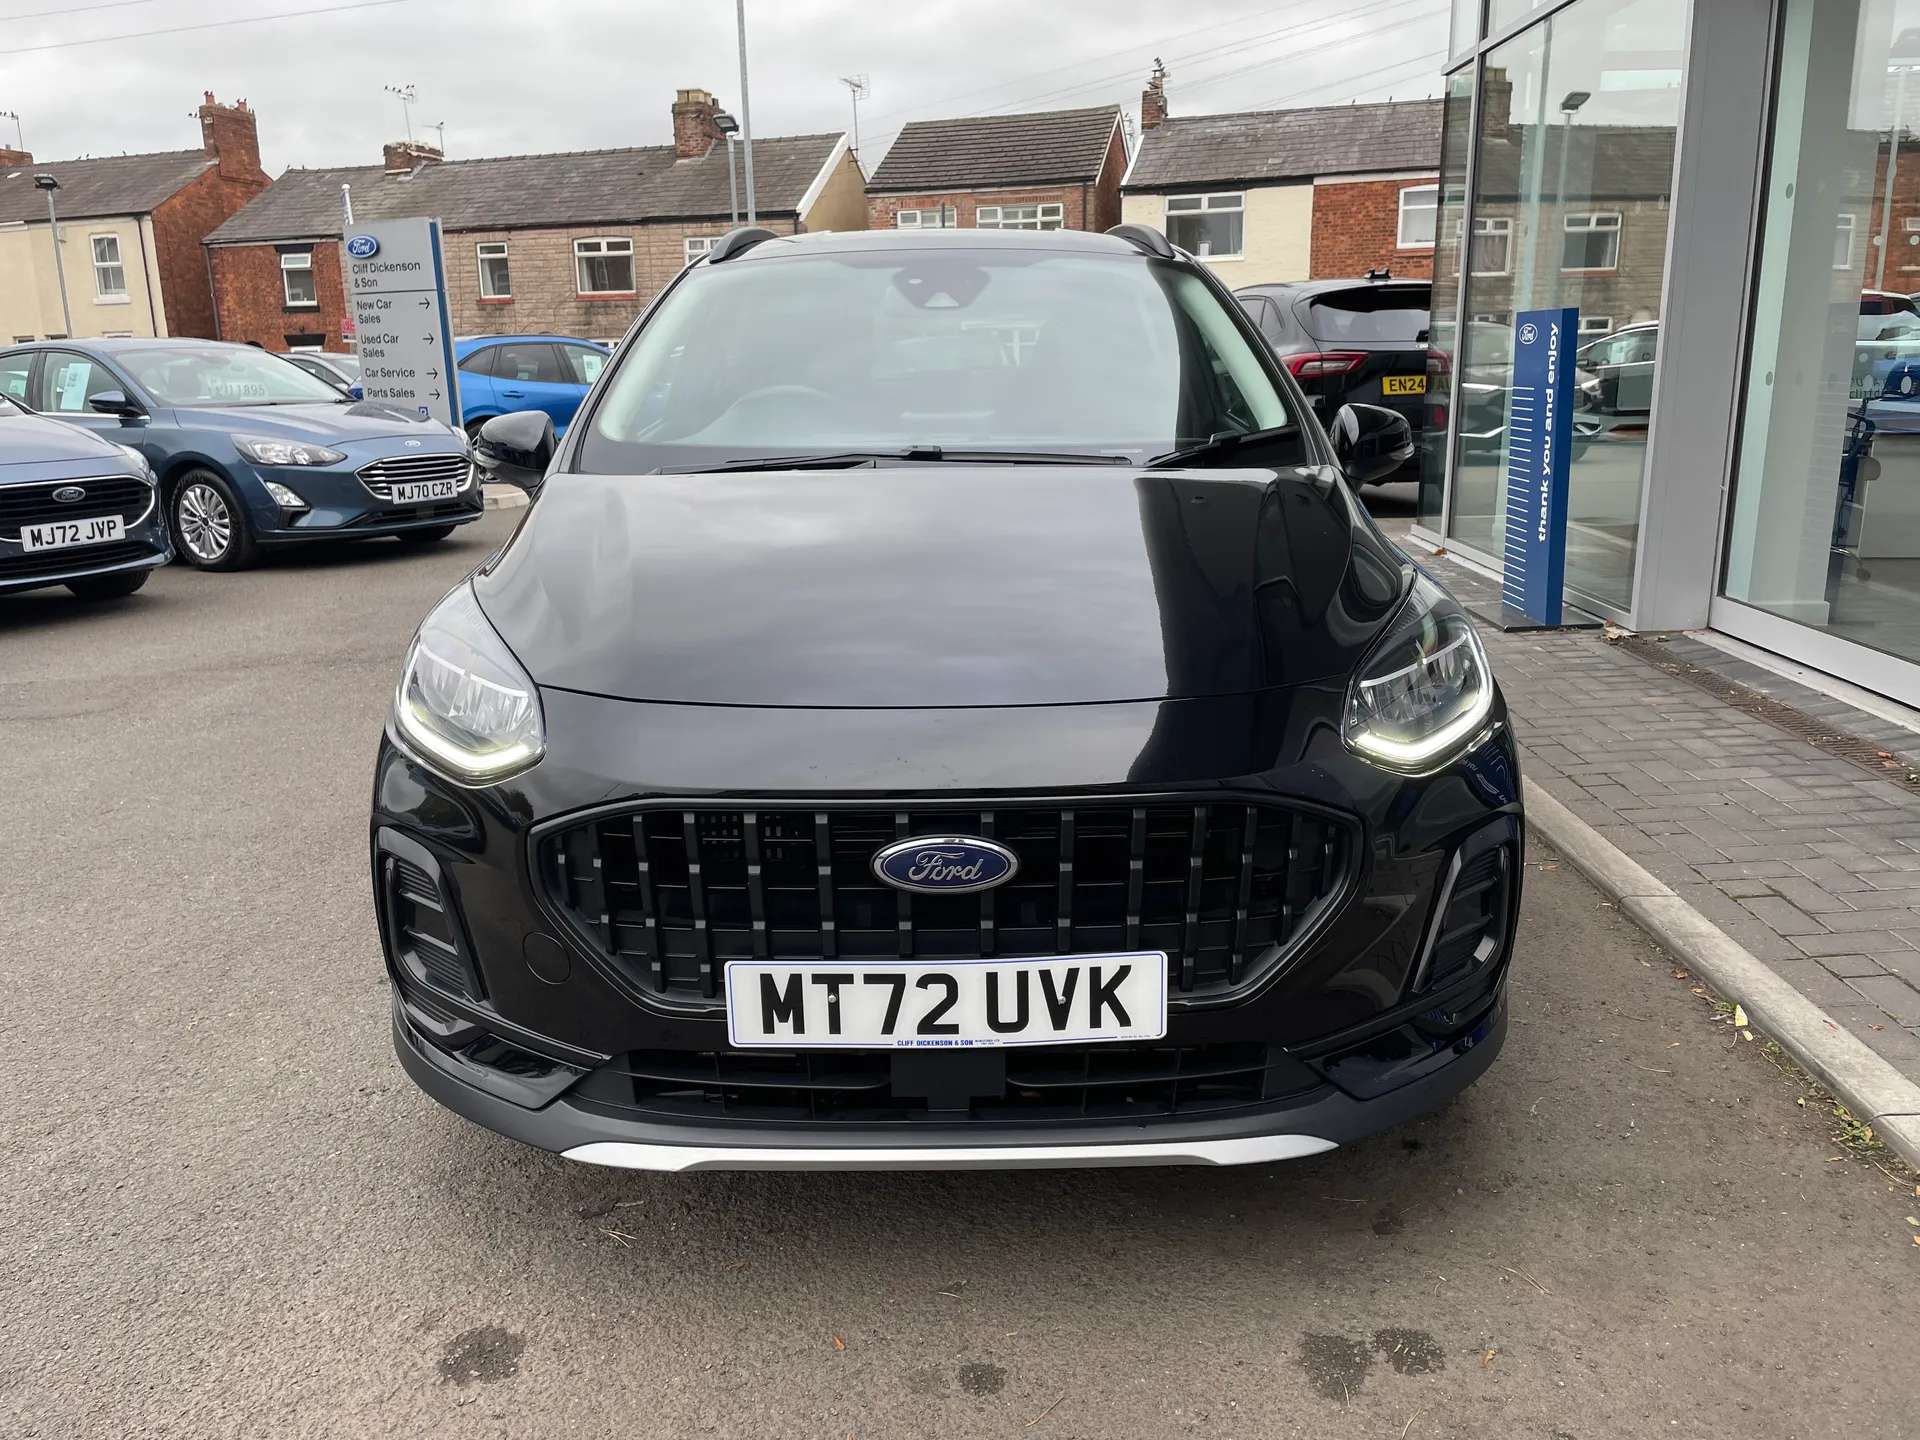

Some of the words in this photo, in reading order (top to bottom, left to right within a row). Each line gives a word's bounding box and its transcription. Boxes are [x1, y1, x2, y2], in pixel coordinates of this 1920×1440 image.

[352, 262, 368, 274] Cliff
[369, 261, 421, 273] Dickenson
[354, 278, 360, 288] &
[361, 277, 378, 288] Son
[356, 300, 374, 310] New
[376, 299, 392, 310] Car
[358, 314, 381, 324] Sales
[361, 334, 381, 345] Used
[383, 333, 399, 344] Car
[362, 347, 385, 358] Sales
[1547, 322, 1559, 384] enjoy
[365, 368, 379, 378] Car
[380, 367, 416, 378] Service
[1389, 378, 1425, 392] EN24
[367, 387, 388, 398] Parts
[389, 387, 416, 398] Sales
[1545, 388, 1554, 432] and
[1542, 435, 1551, 475] you
[397, 484, 429, 500] MJ70
[432, 481, 453, 497] CZR
[1538, 480, 1548, 543] thank
[30, 525, 81, 547] MJ72
[86, 520, 117, 540] JVP
[759, 972, 960, 1035] MT72
[985, 964, 1132, 1033] UVK
